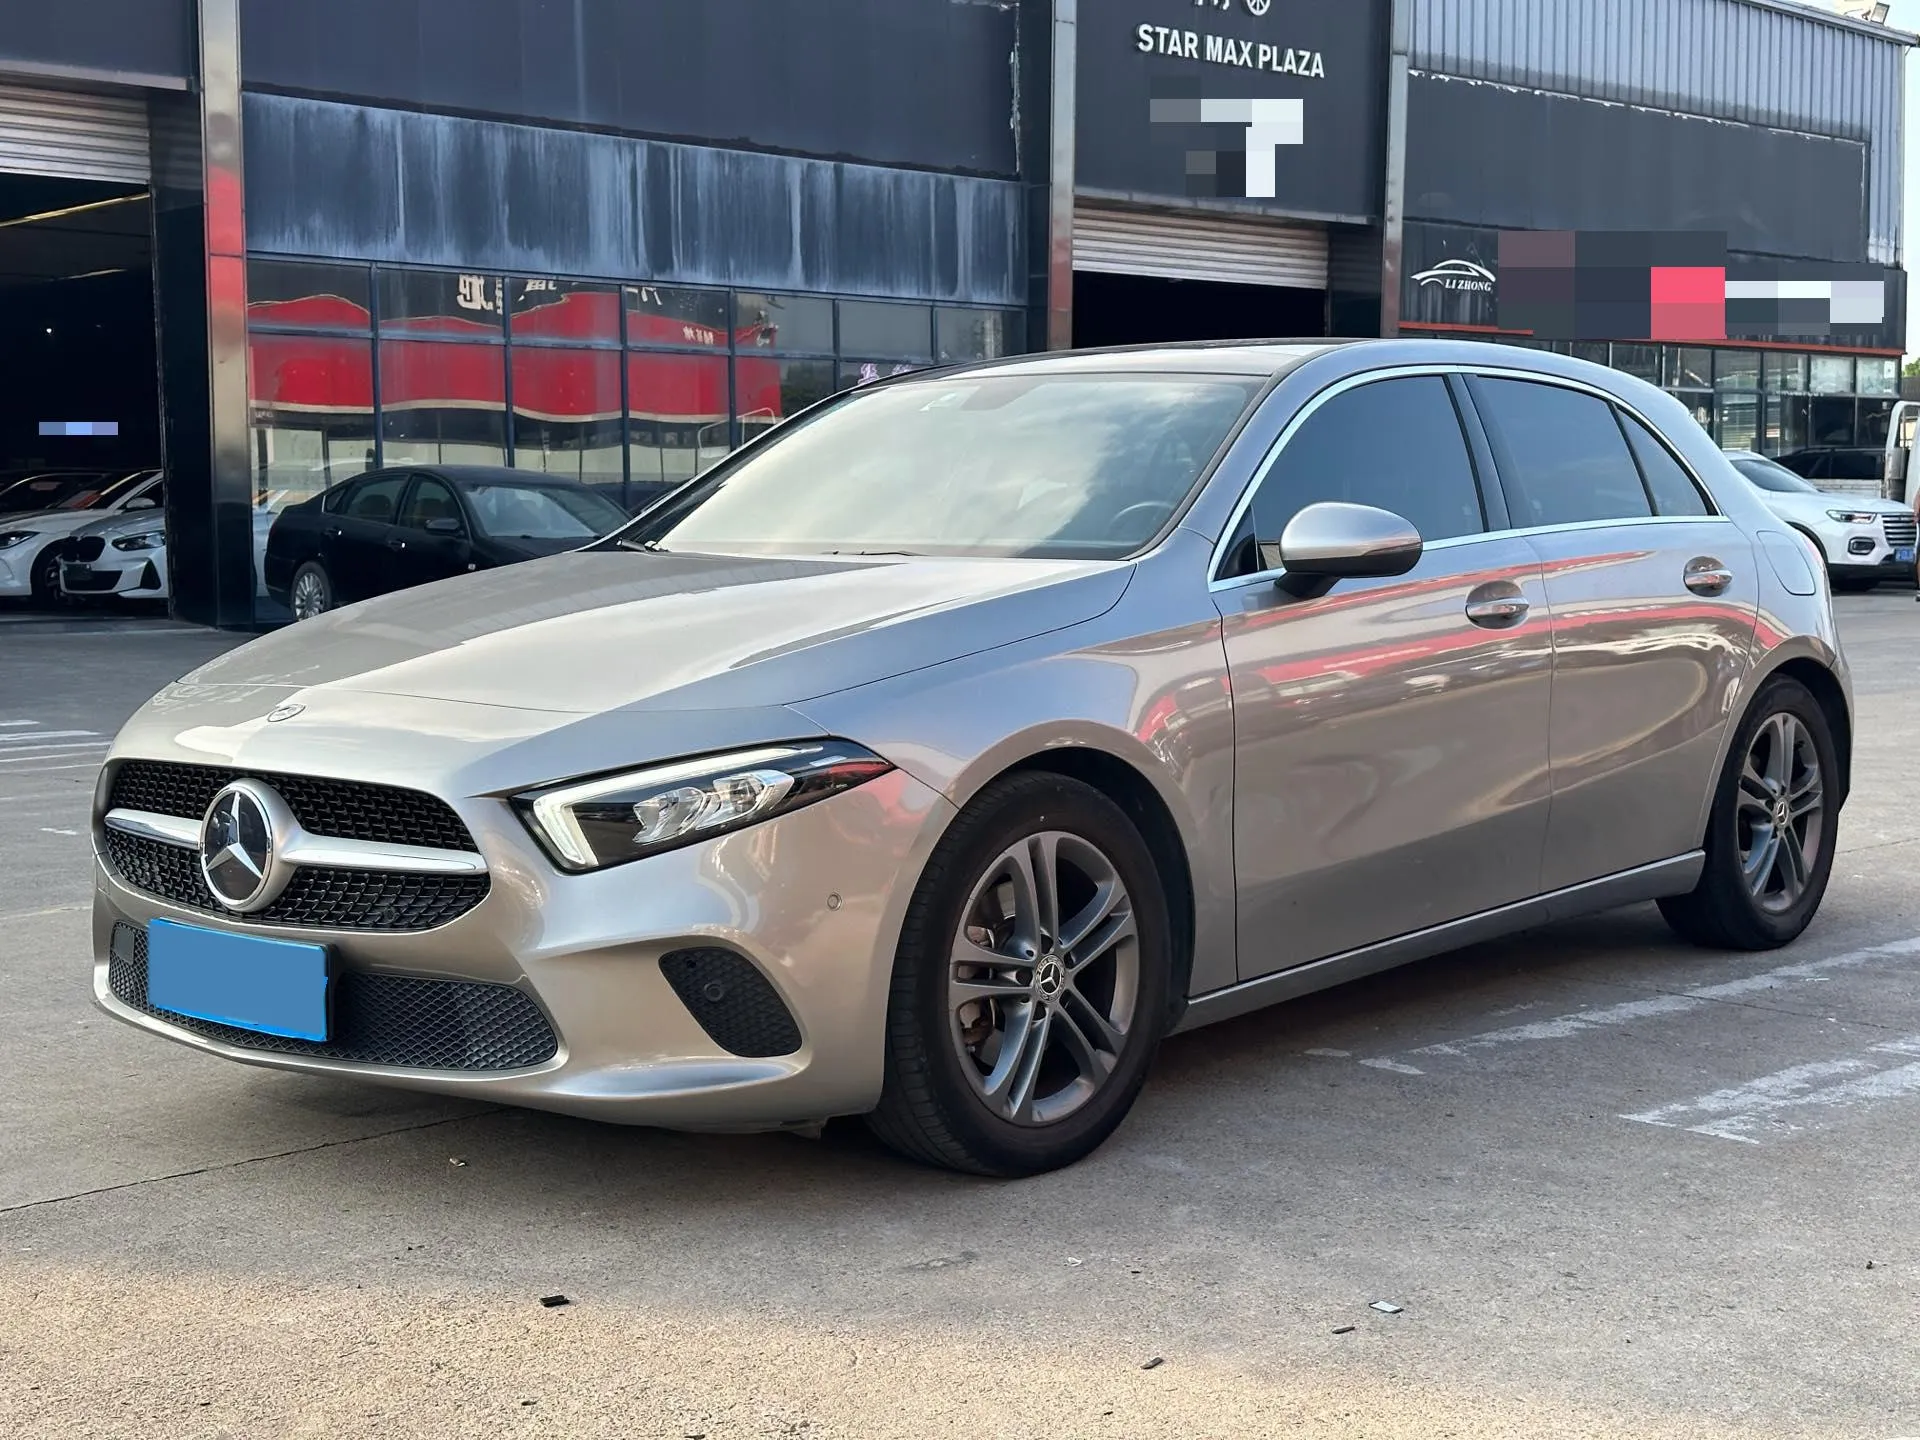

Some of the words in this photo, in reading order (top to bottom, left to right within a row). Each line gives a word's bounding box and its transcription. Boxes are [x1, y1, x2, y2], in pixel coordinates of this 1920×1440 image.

[1137, 23, 1198, 59] STAR
[1206, 34, 1253, 67] MAX
[1258, 43, 1325, 78] PLAZA
[1445, 278, 1456, 289] LI
[1457, 280, 1492, 291] ZHONG
